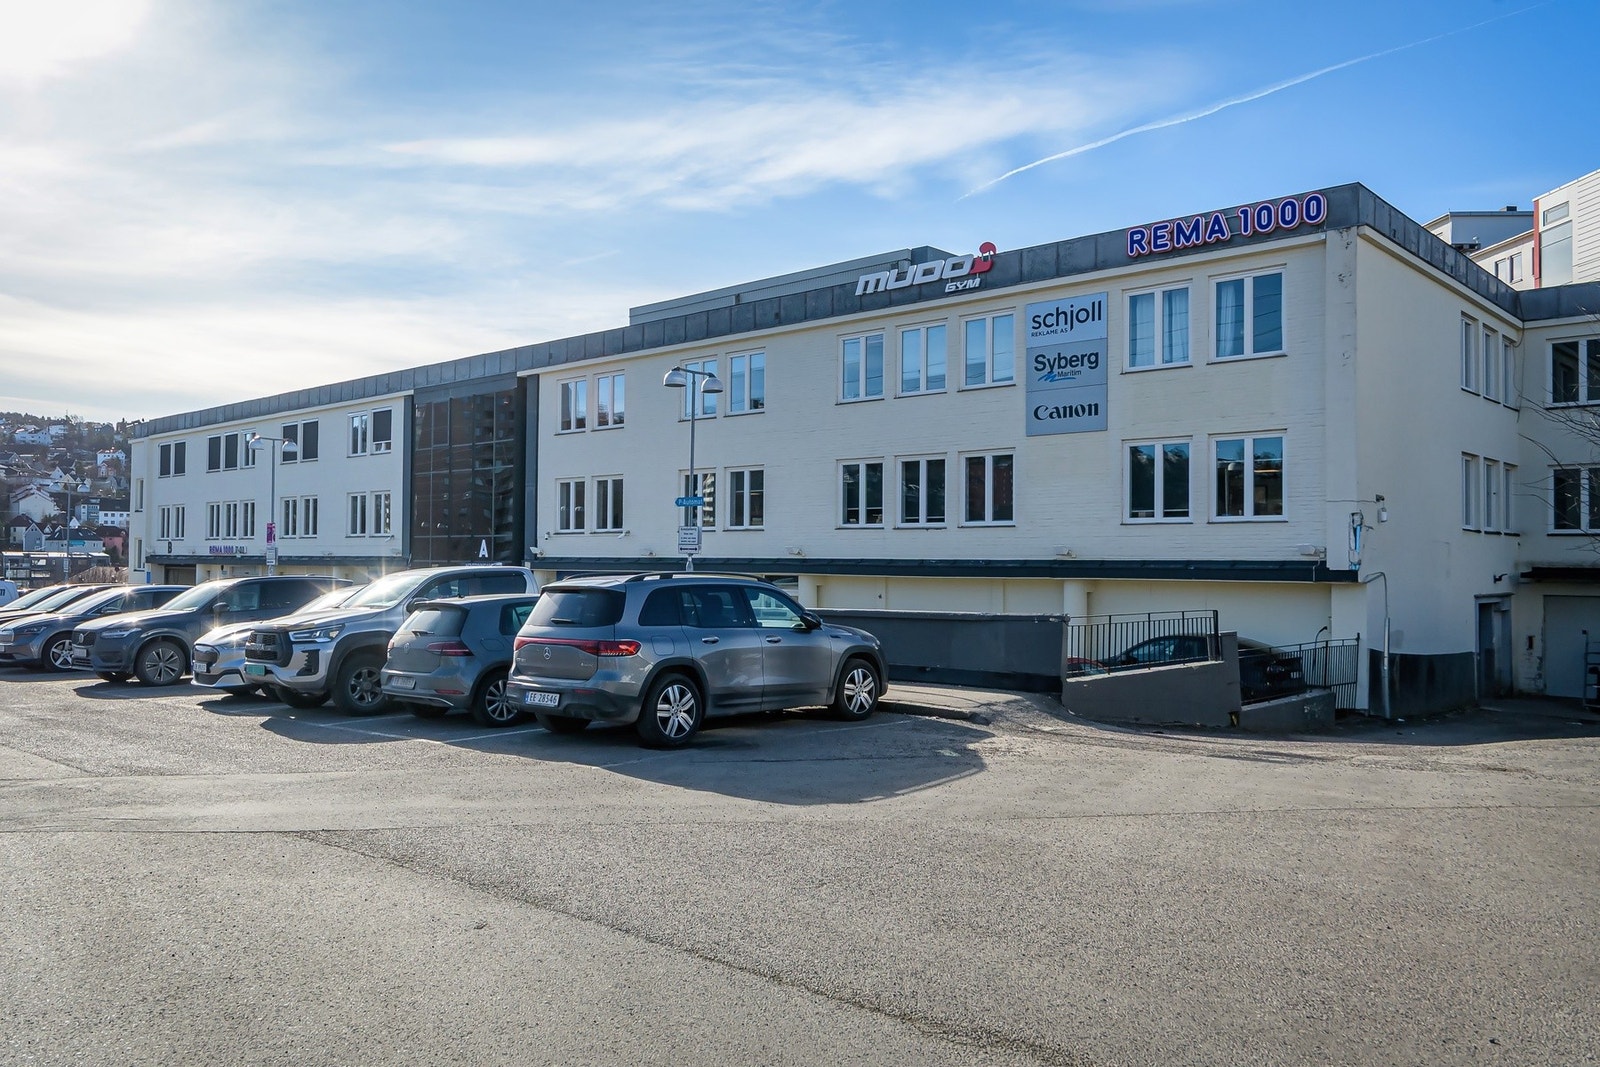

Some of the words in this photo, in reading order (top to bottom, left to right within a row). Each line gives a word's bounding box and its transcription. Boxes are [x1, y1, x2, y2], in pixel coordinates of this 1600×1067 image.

[1127, 212, 1230, 258] REMA
[1237, 191, 1327, 237] 1000
[855, 254, 974, 296] MUDO
[945, 277, 981, 293] GYM
[1031, 300, 1102, 331] schjoll
[1031, 328, 1059, 338] REKLAME
[1034, 351, 1099, 374] Syberg
[1057, 369, 1082, 378] Maritim
[1033, 402, 1099, 421] Canon
[167, 541, 173, 554] B
[478, 539, 489, 558] A
[529, 692, 537, 702] EE
[538, 693, 557, 704] 28546
